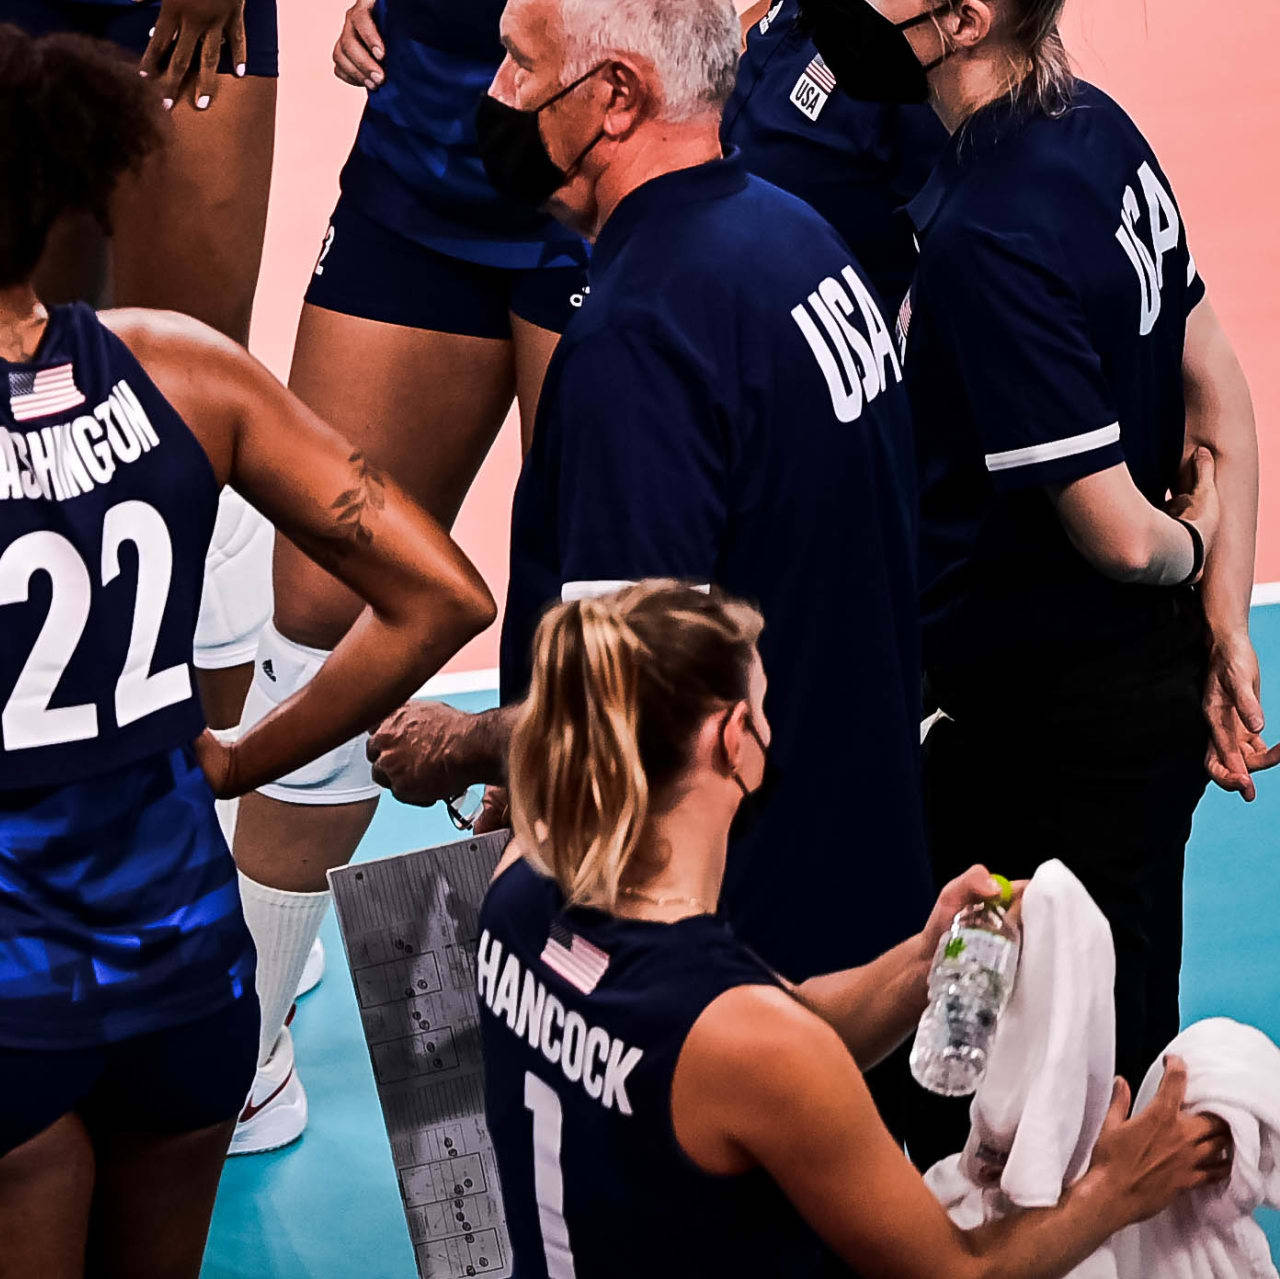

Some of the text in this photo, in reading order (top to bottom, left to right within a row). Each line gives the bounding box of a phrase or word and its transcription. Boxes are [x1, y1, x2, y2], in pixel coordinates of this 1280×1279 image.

[796, 80, 820, 114] USA
[1115, 161, 1179, 335] USA
[791, 265, 903, 423] USA
[477, 929, 643, 1116] HANCOCK
[523, 1072, 577, 1279] 1
